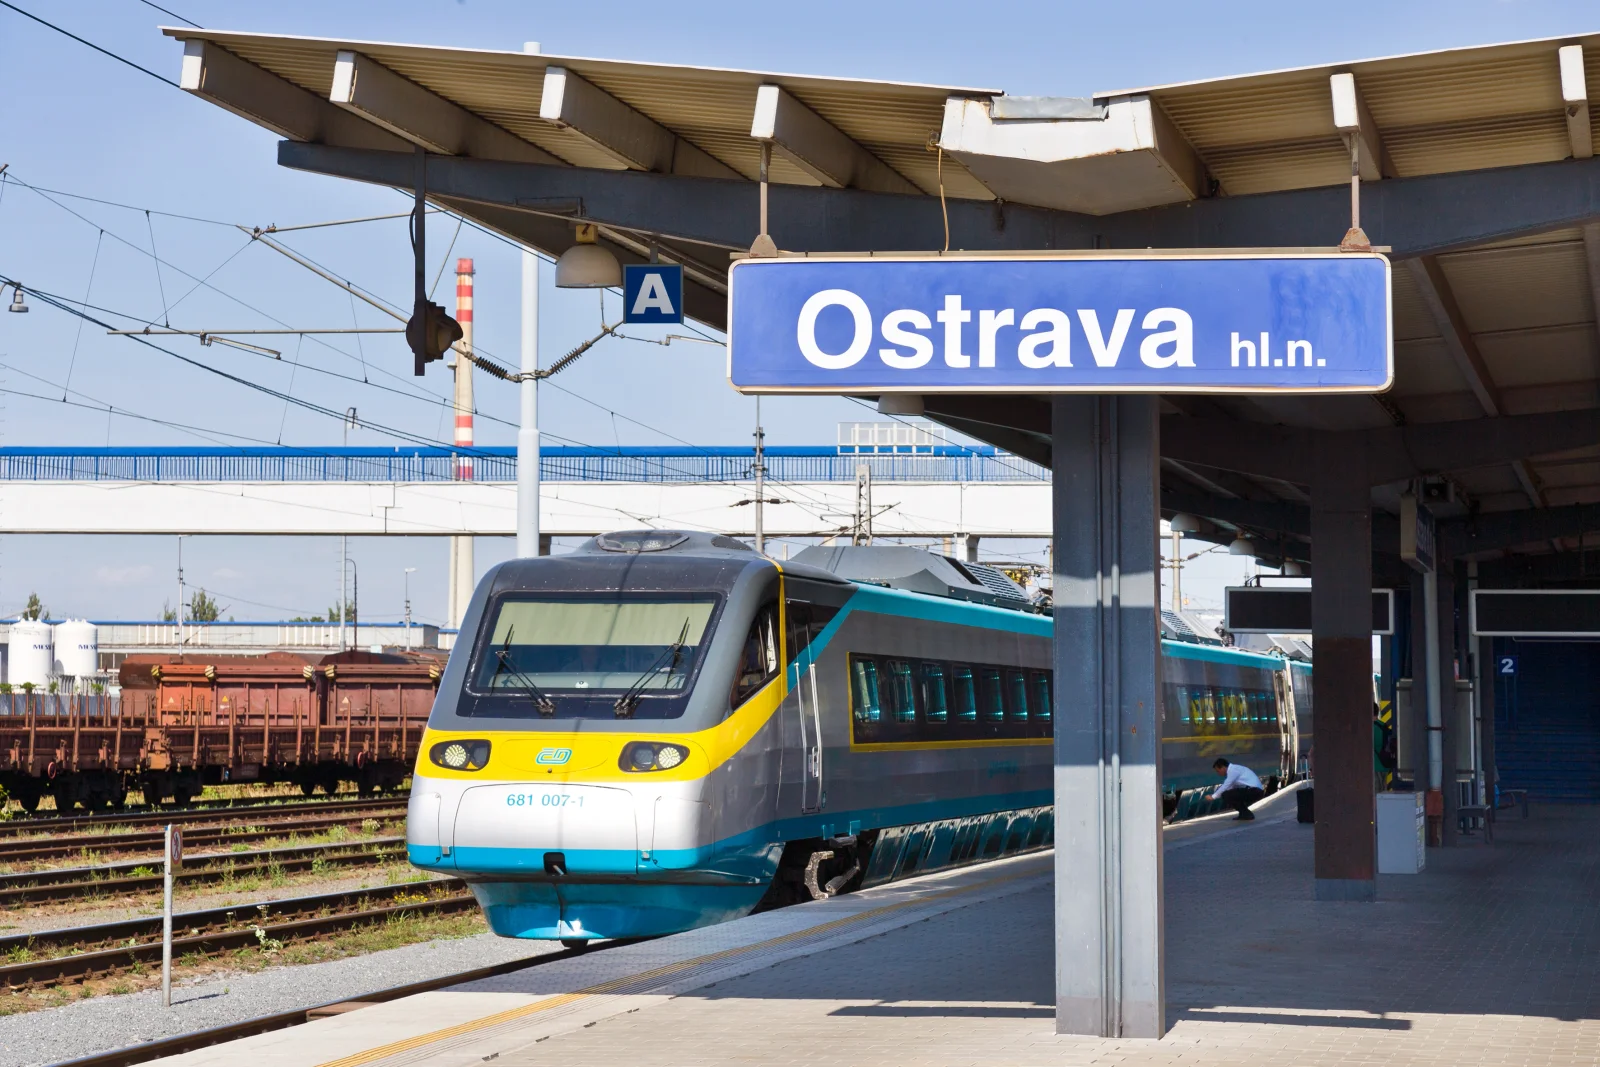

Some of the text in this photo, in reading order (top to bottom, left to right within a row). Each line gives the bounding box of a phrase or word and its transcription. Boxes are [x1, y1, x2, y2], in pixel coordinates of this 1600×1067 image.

[631, 273, 675, 314] A
[796, 288, 1327, 370] Ostrava hl.n.
[1501, 658, 1514, 673] 2
[507, 793, 584, 807] 681 007-1
